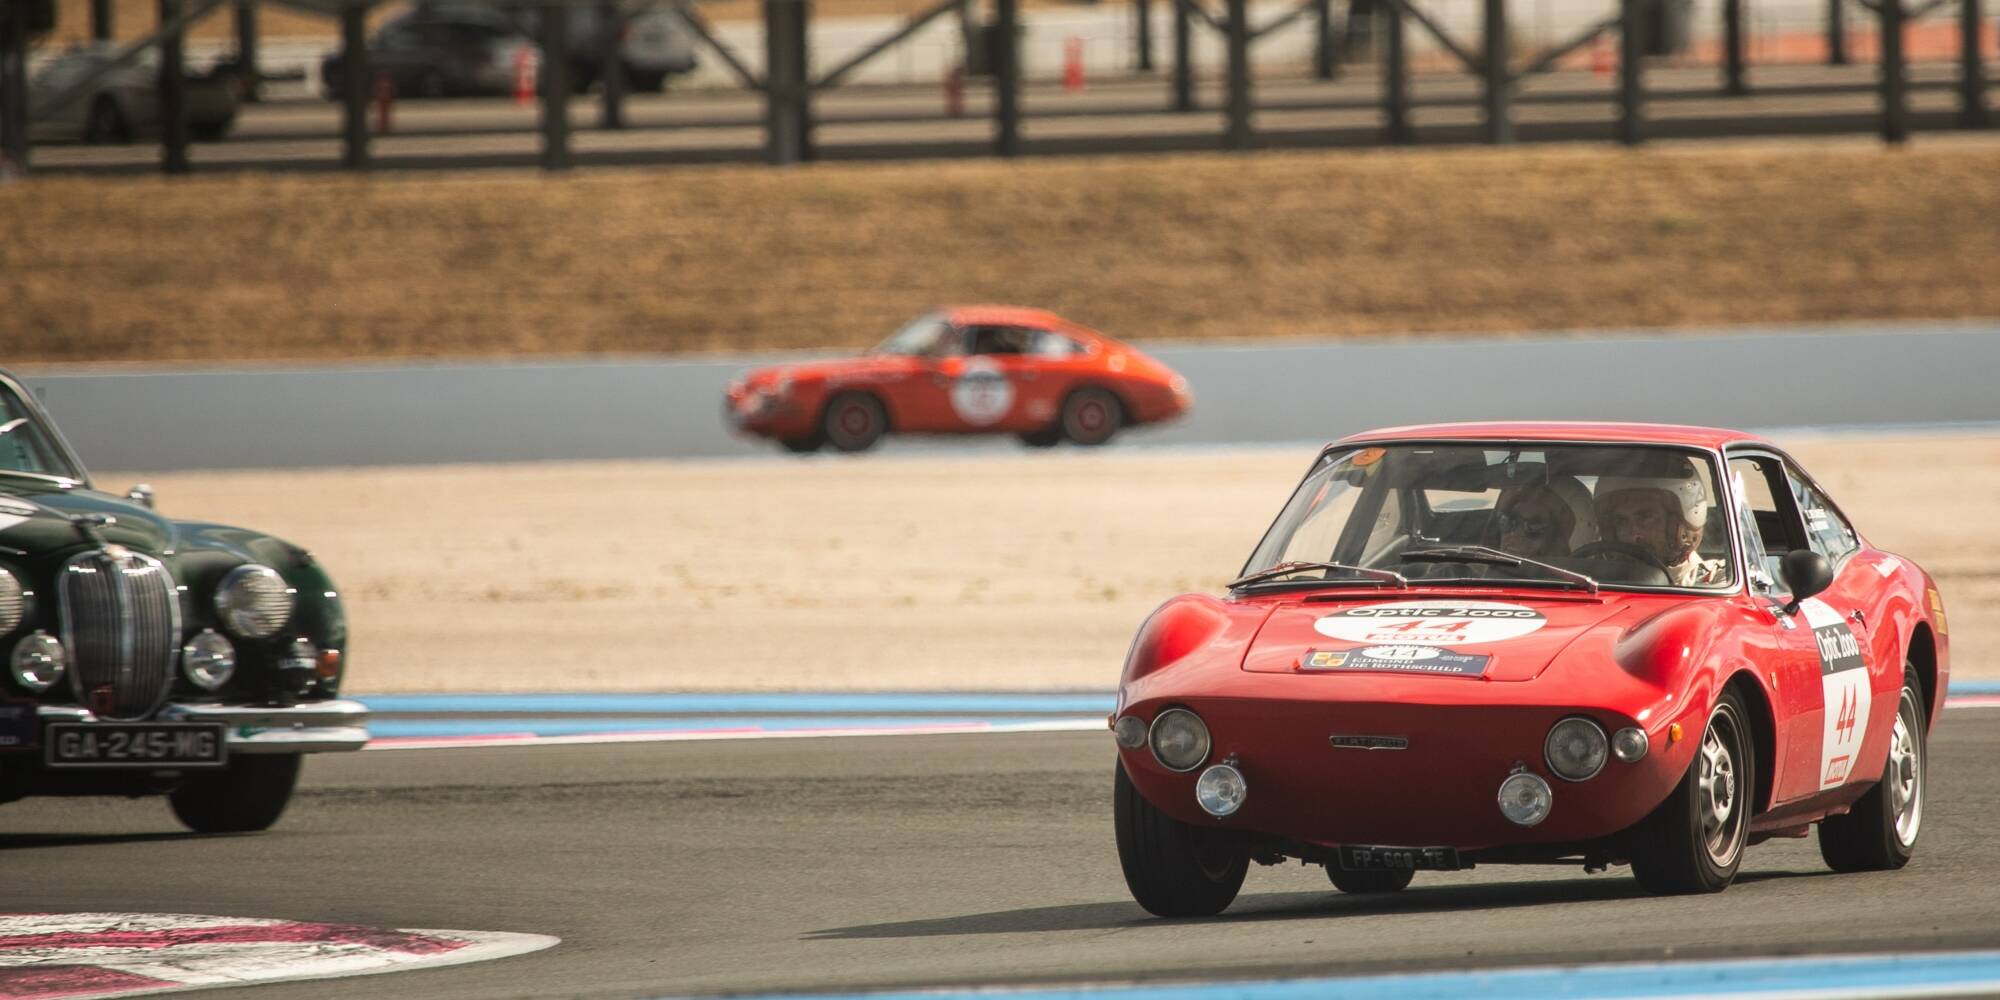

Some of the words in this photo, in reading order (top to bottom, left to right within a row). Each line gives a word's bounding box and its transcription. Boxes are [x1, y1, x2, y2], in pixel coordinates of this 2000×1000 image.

[1346, 607, 1441, 617] Optic
[1448, 608, 1537, 618] 2000
[1377, 620, 1473, 633] 44
[1381, 649, 1417, 658] 44
[1816, 629, 1841, 671] Optic
[1834, 628, 1859, 657] 2000
[1349, 662, 1368, 670] DE
[1371, 663, 1463, 673] ROTHSCHILD
[1836, 683, 1857, 745] 44
[59, 732, 215, 758] GA-245-MG
